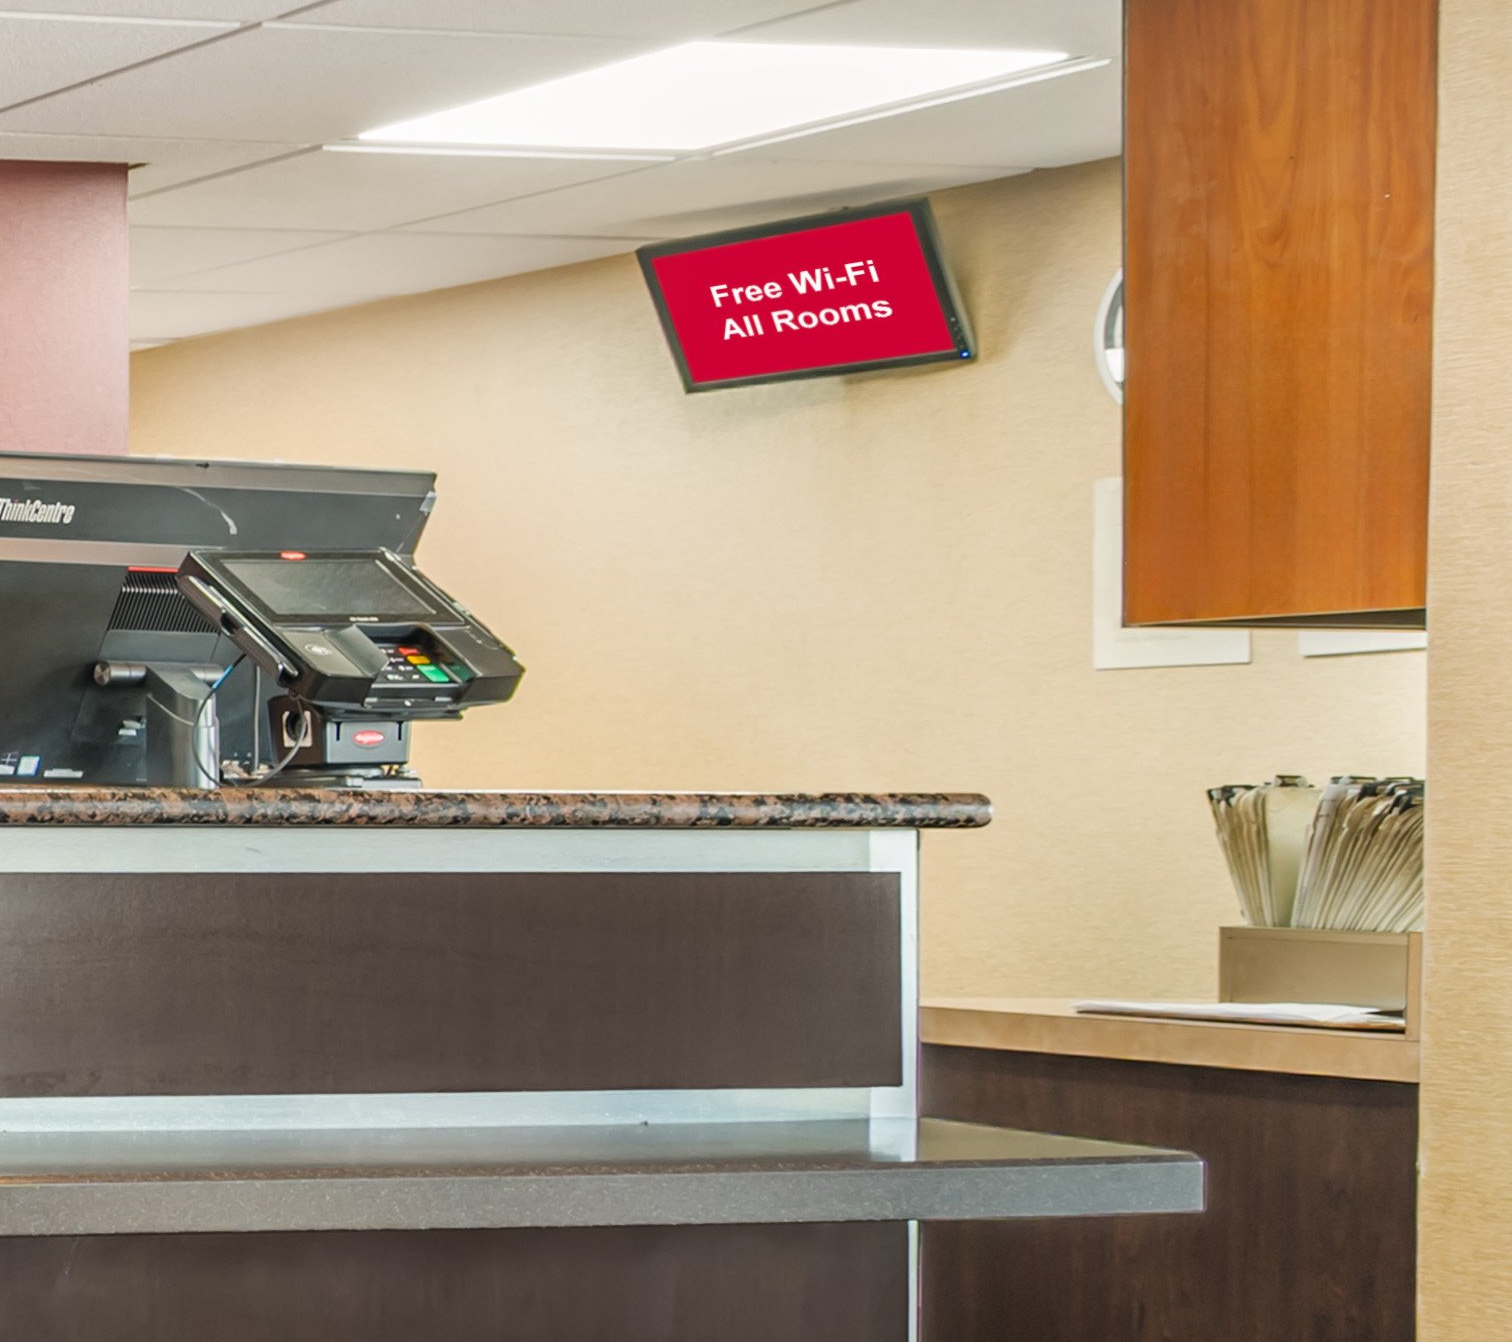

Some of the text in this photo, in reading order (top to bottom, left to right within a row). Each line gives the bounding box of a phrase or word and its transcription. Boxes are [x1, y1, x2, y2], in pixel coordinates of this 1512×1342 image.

[709, 259, 880, 308] Free Wi-Fi
[723, 299, 893, 341] All Rooms
